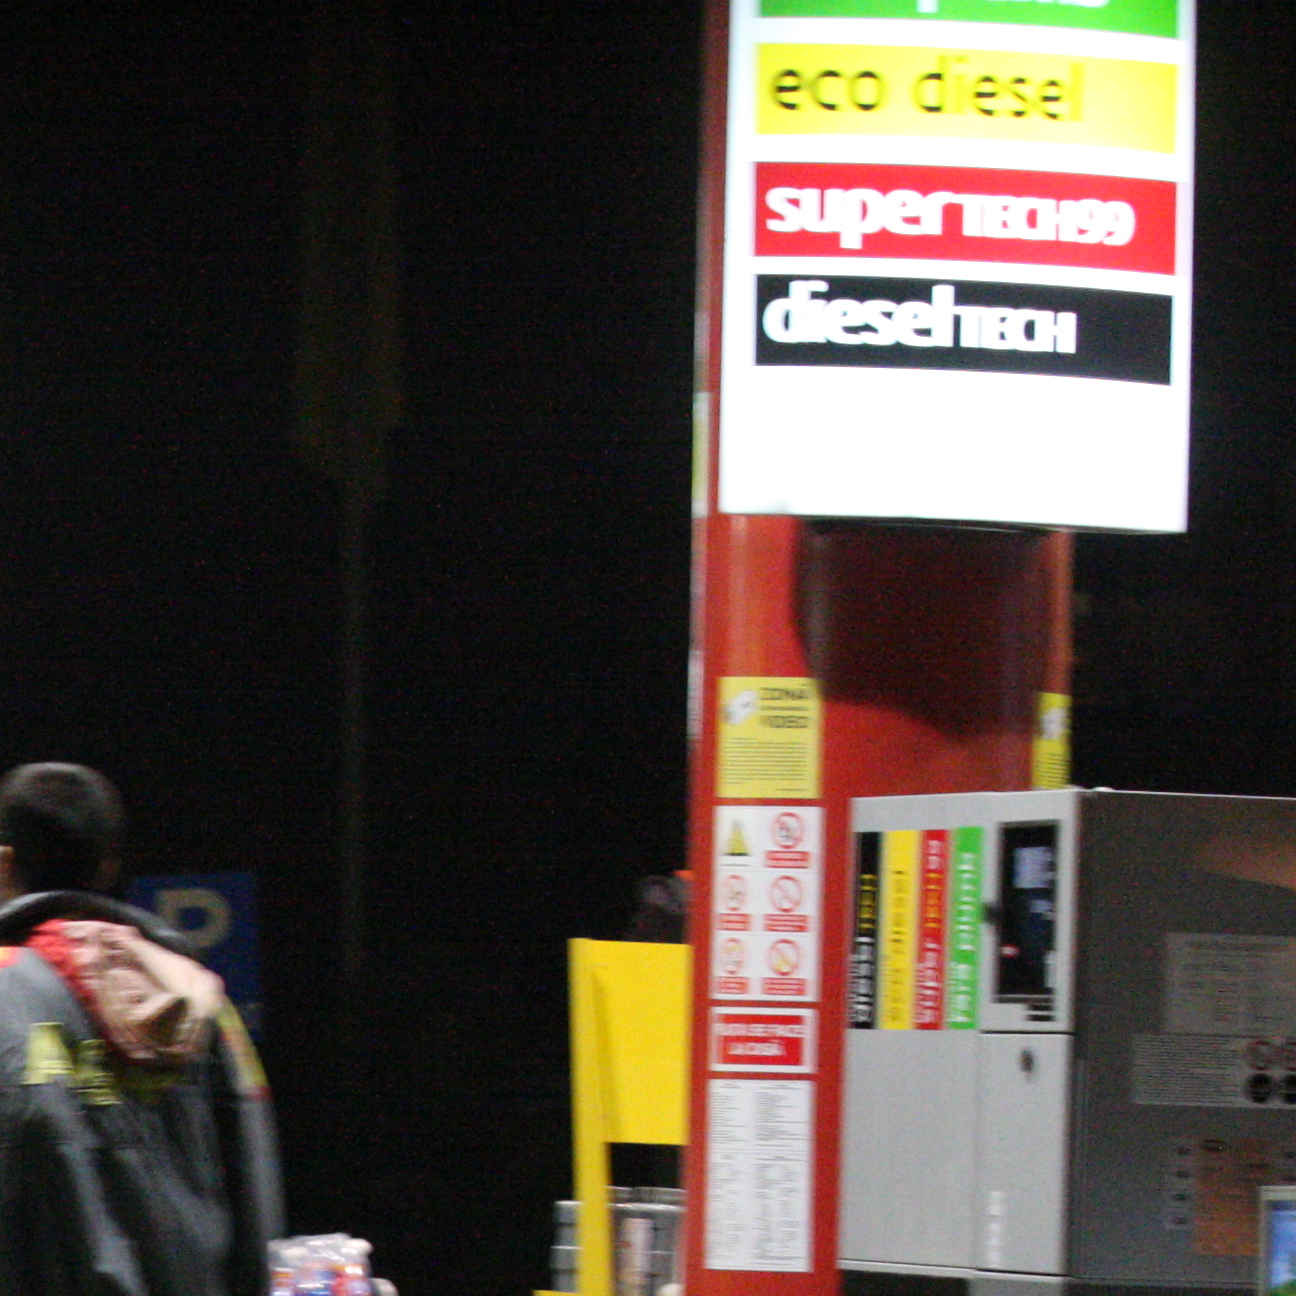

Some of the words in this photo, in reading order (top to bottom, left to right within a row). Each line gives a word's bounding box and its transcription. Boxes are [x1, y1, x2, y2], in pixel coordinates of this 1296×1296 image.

[770, 68, 888, 112] eco
[912, 55, 1085, 122] diesel
[761, 279, 1077, 354] dieselTECH
